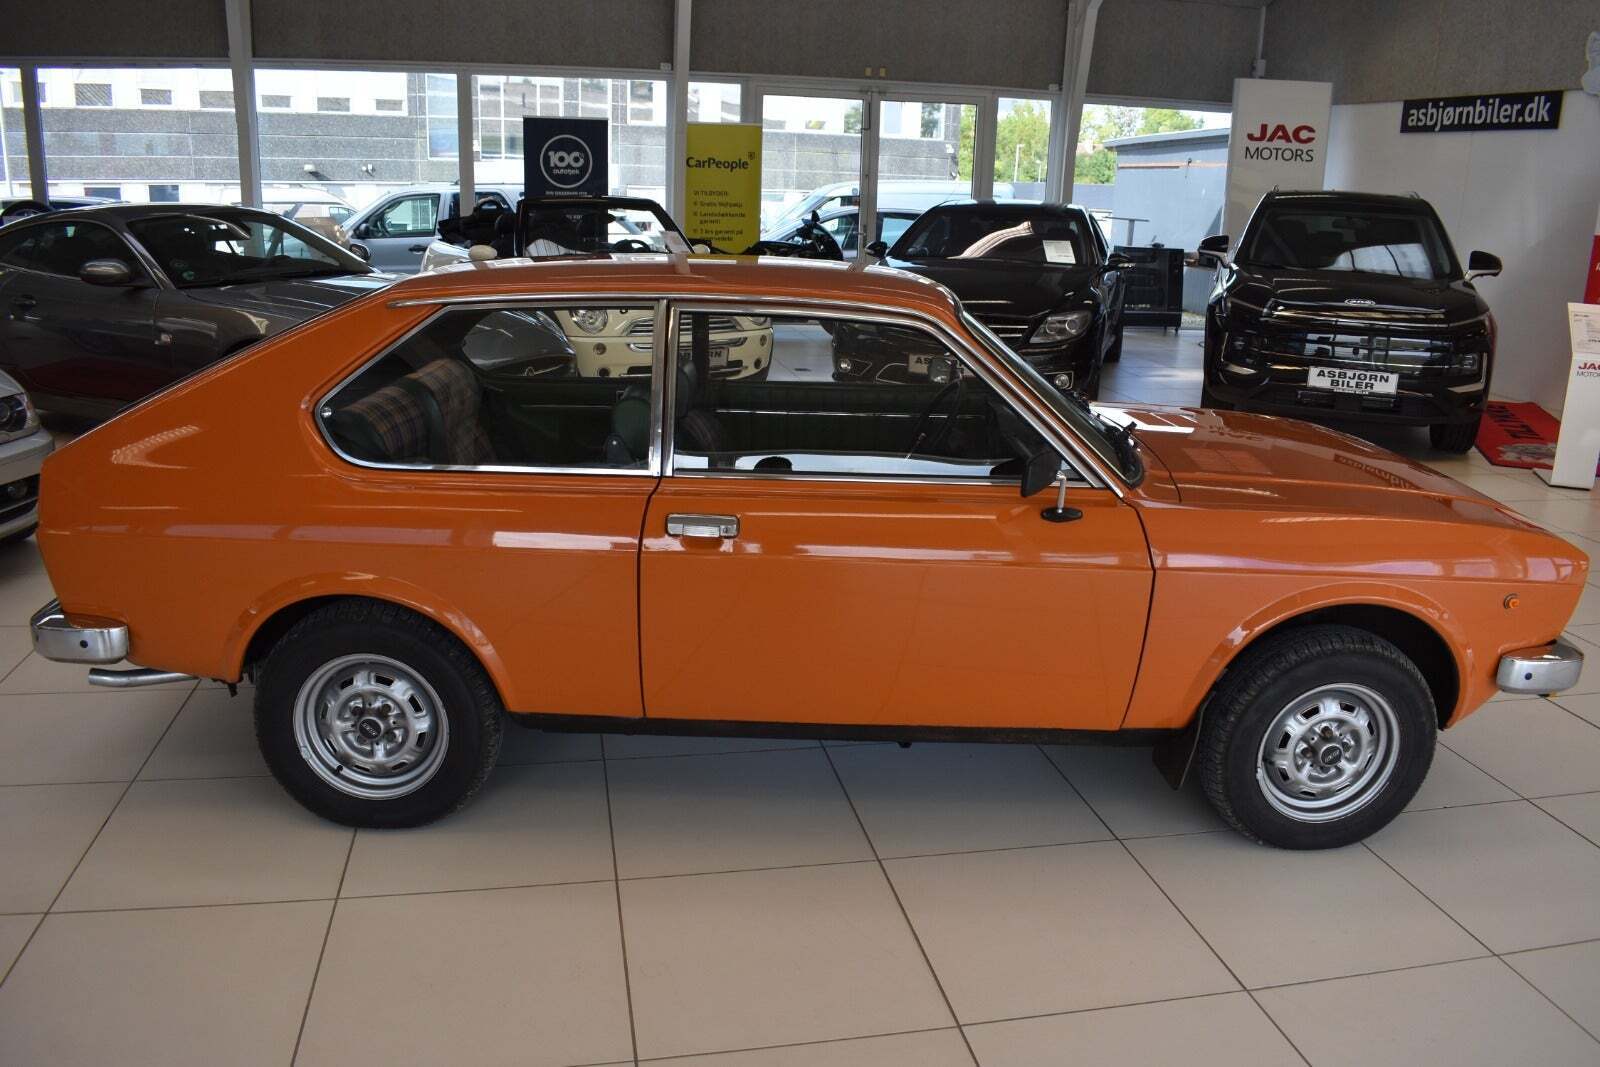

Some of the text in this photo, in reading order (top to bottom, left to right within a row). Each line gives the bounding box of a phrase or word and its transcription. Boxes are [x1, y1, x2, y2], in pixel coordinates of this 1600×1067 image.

[1407, 94, 1550, 132] asbjørnbiler.dk
[1247, 123, 1316, 144] JAC
[1245, 146, 1314, 163] MOTORS
[686, 156, 749, 172] CarPeople
[1317, 369, 1390, 383] ASBJØRN
[1330, 379, 1374, 390] BILER
